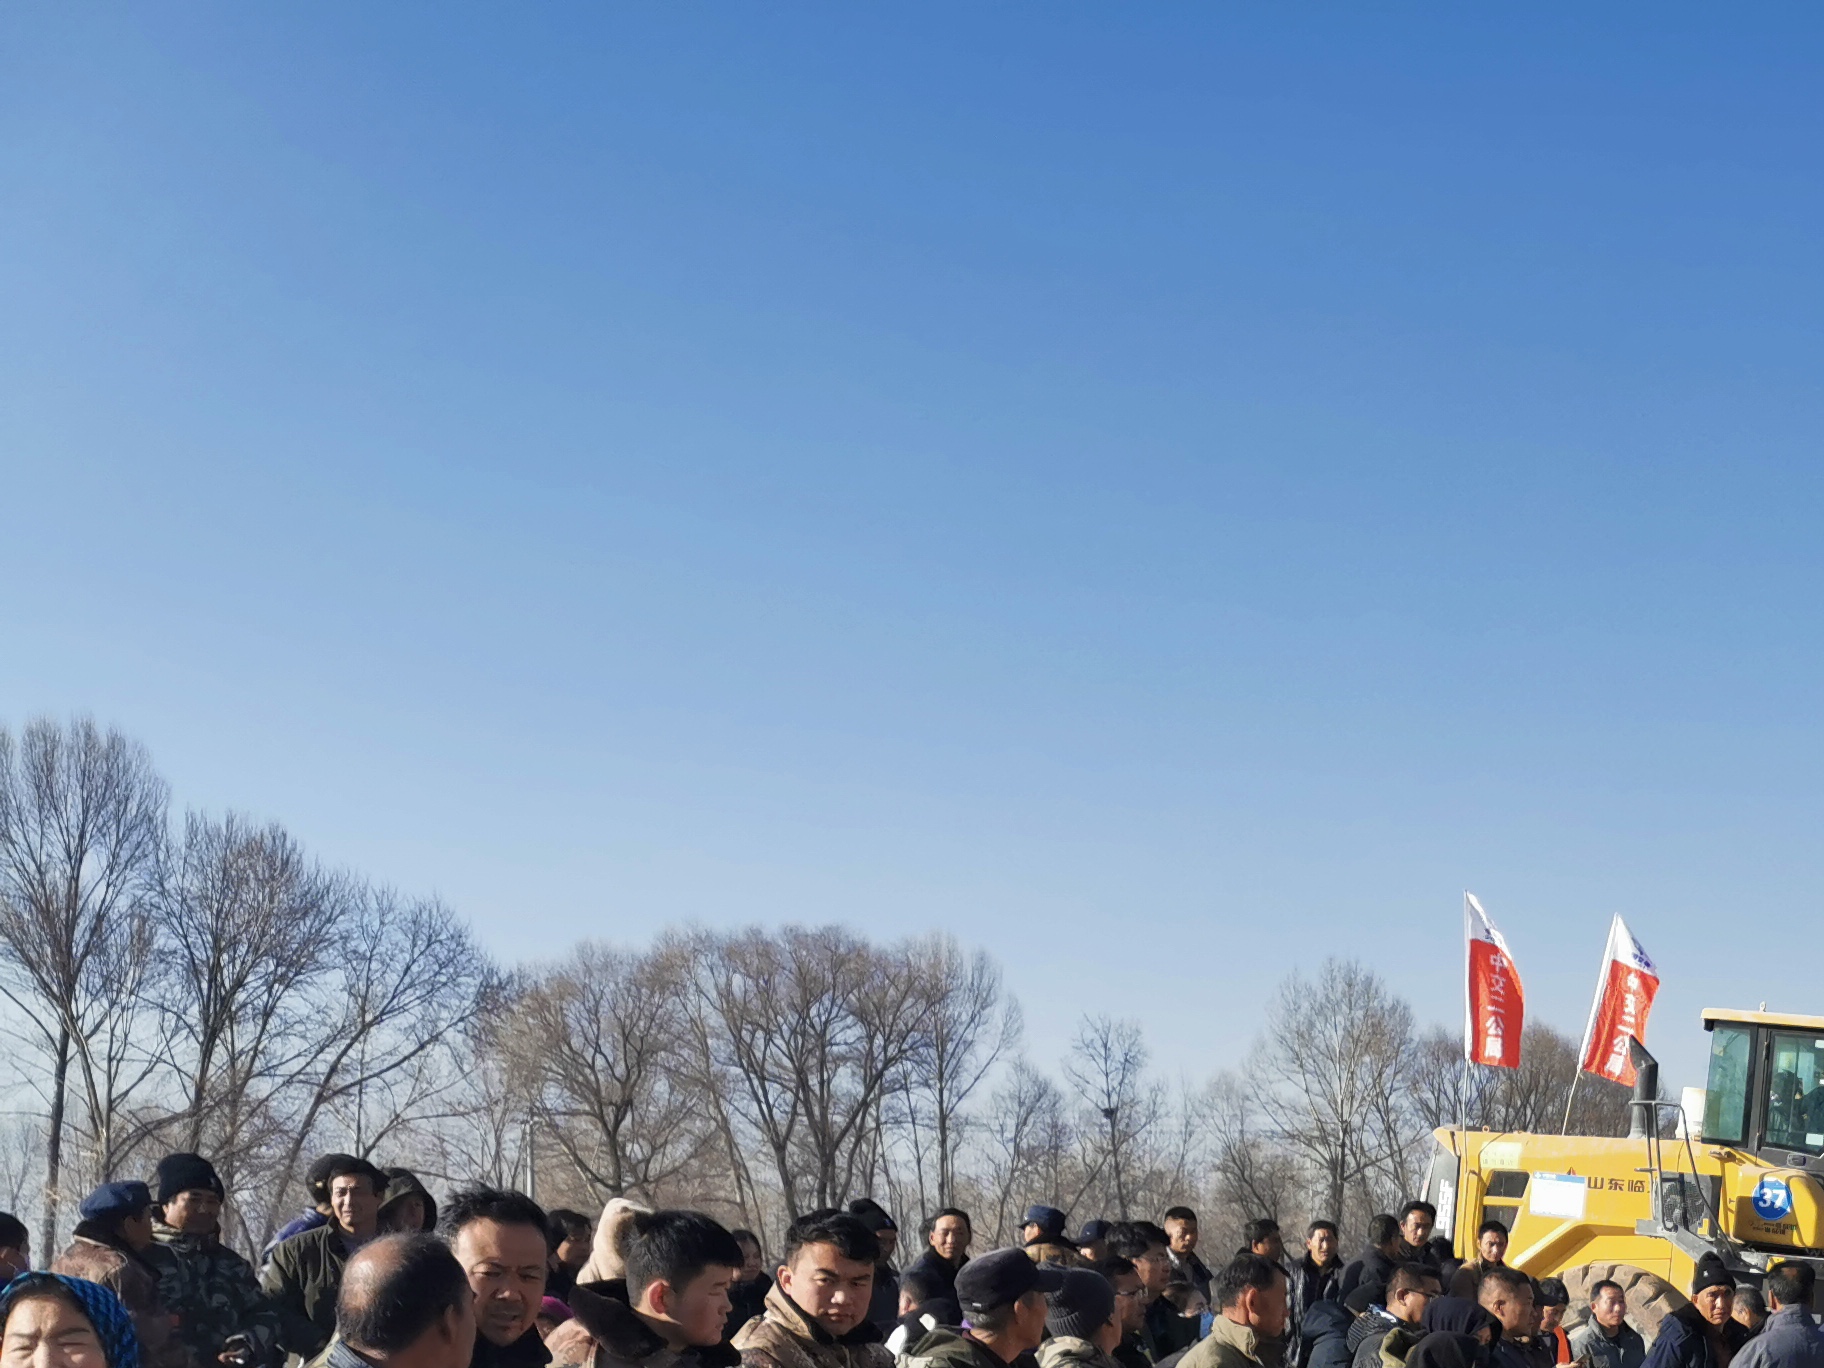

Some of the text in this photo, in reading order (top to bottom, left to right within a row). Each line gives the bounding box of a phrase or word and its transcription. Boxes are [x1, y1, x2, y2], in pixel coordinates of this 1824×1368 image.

[1587, 1176, 1650, 1194] 山东临
[1758, 1187, 1787, 1209] 37
